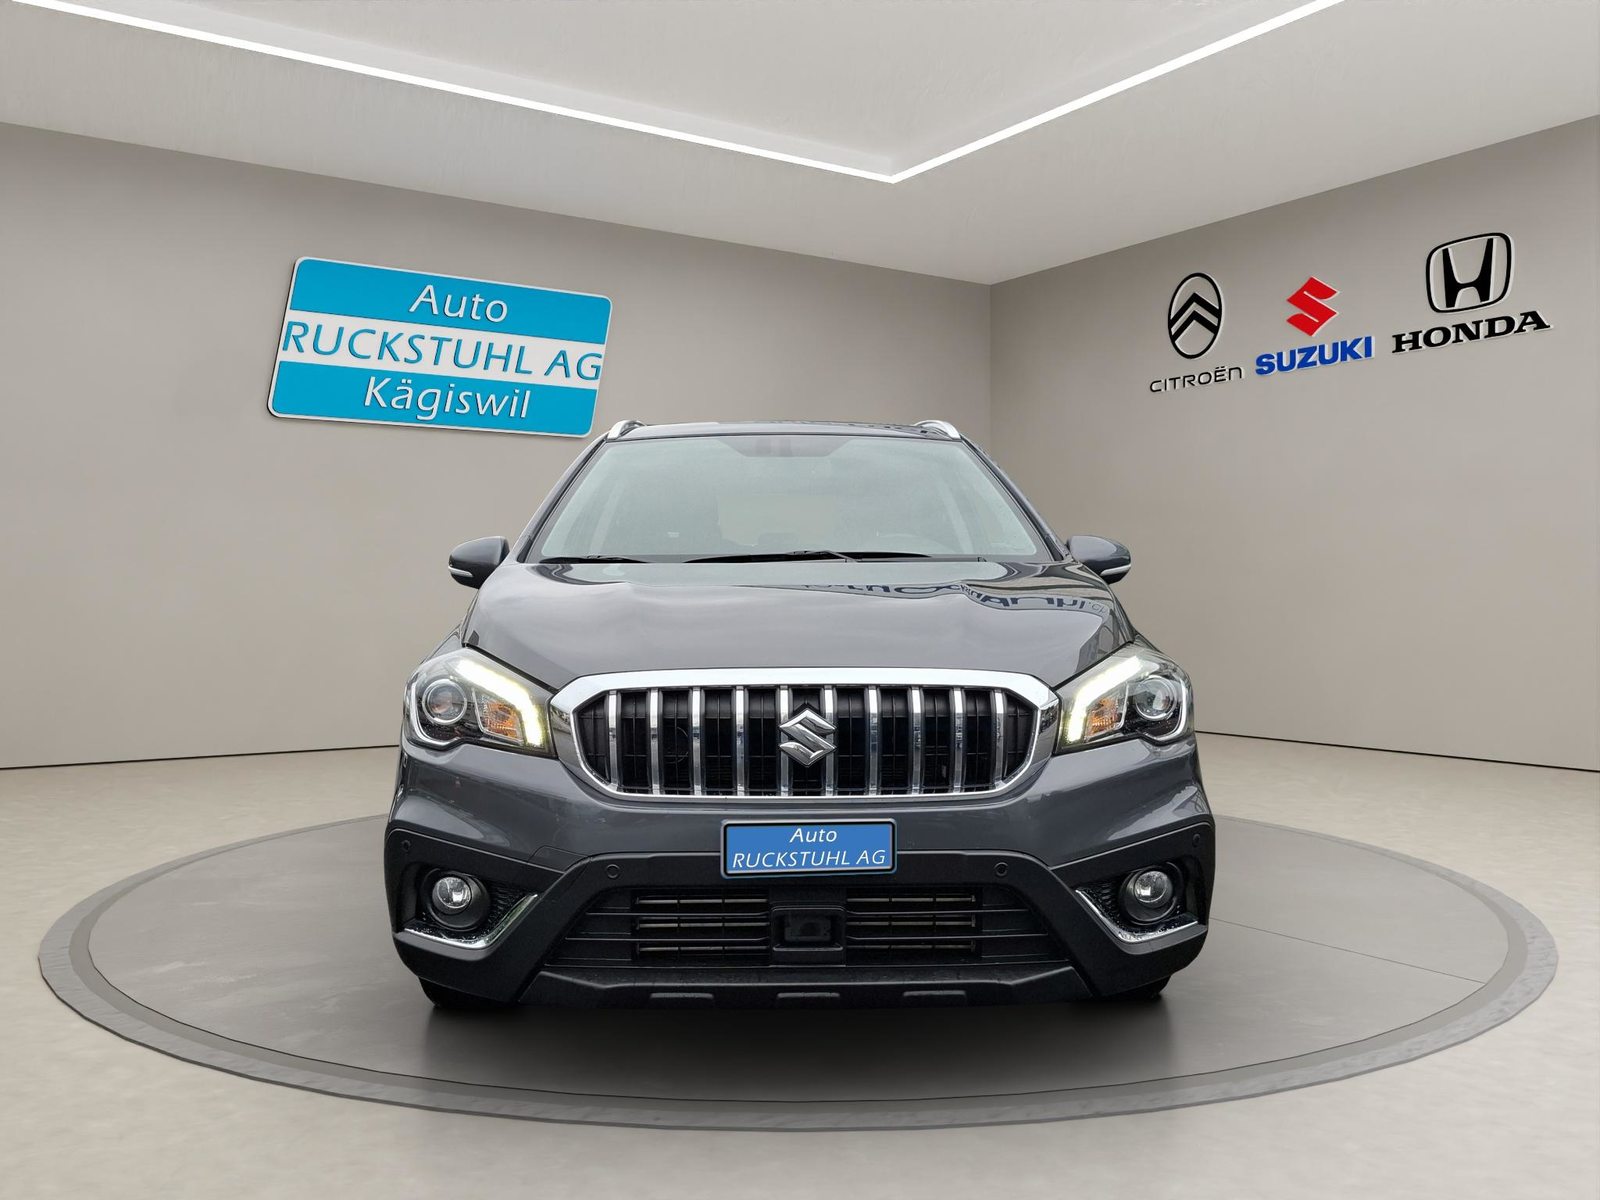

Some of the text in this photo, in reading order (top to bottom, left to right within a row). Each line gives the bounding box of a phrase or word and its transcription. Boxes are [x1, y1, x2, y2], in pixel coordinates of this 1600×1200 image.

[409, 284, 508, 323] Auto
[282, 320, 603, 381] RUCKSTUHL AG
[1391, 310, 1551, 354] HONDA
[1255, 335, 1373, 376] SUZUKI
[364, 376, 531, 420] Kägiswil
[789, 828, 838, 843] Auto
[732, 849, 886, 868] RUCKSTUHL AG
